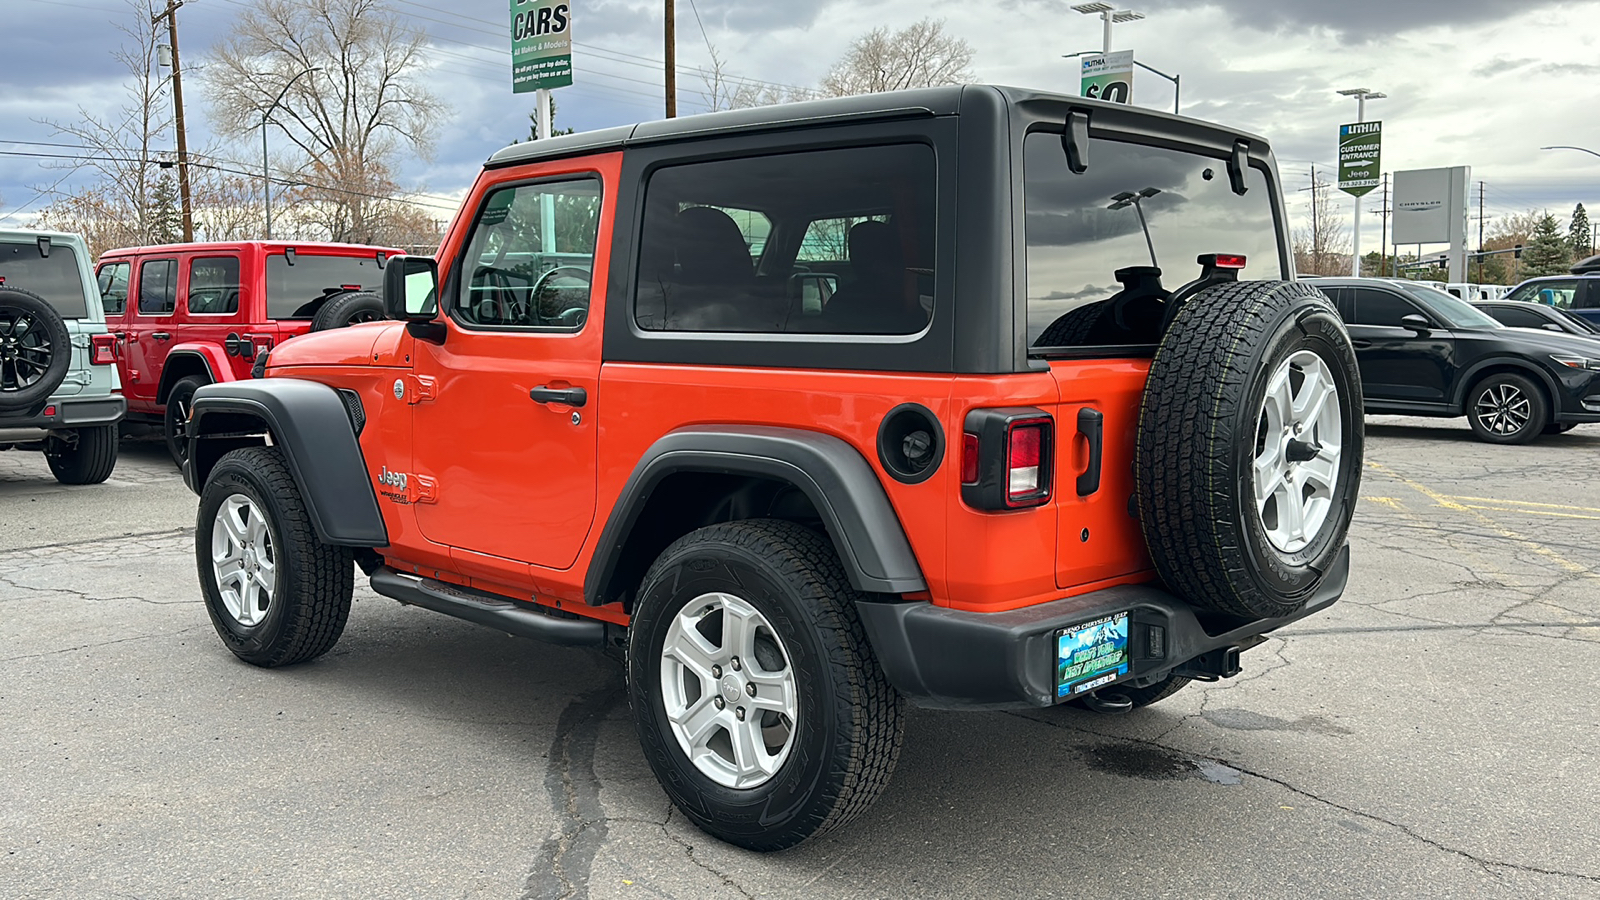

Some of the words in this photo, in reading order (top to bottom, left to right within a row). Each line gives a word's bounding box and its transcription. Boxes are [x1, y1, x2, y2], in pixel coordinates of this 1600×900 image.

[513, 4, 569, 42] CARS
[521, 45, 537, 55] Makes
[543, 40, 568, 50] Models
[1348, 123, 1380, 135] LITHIA
[1340, 143, 1380, 153] CUSTOMER
[1340, 150, 1379, 160] ENTRANCE
[1347, 170, 1370, 178] Jeep
[378, 465, 407, 492] Jeep
[1063, 625, 1080, 635] RENO
[1081, 616, 1112, 630] CHRYSLER
[1113, 611, 1128, 620] JEEP
[1074, 646, 1098, 664] WHAT'S
[1097, 641, 1115, 657] YOUR
[1064, 663, 1084, 680] NEXT
[1082, 649, 1123, 674] ADVENTURE?
